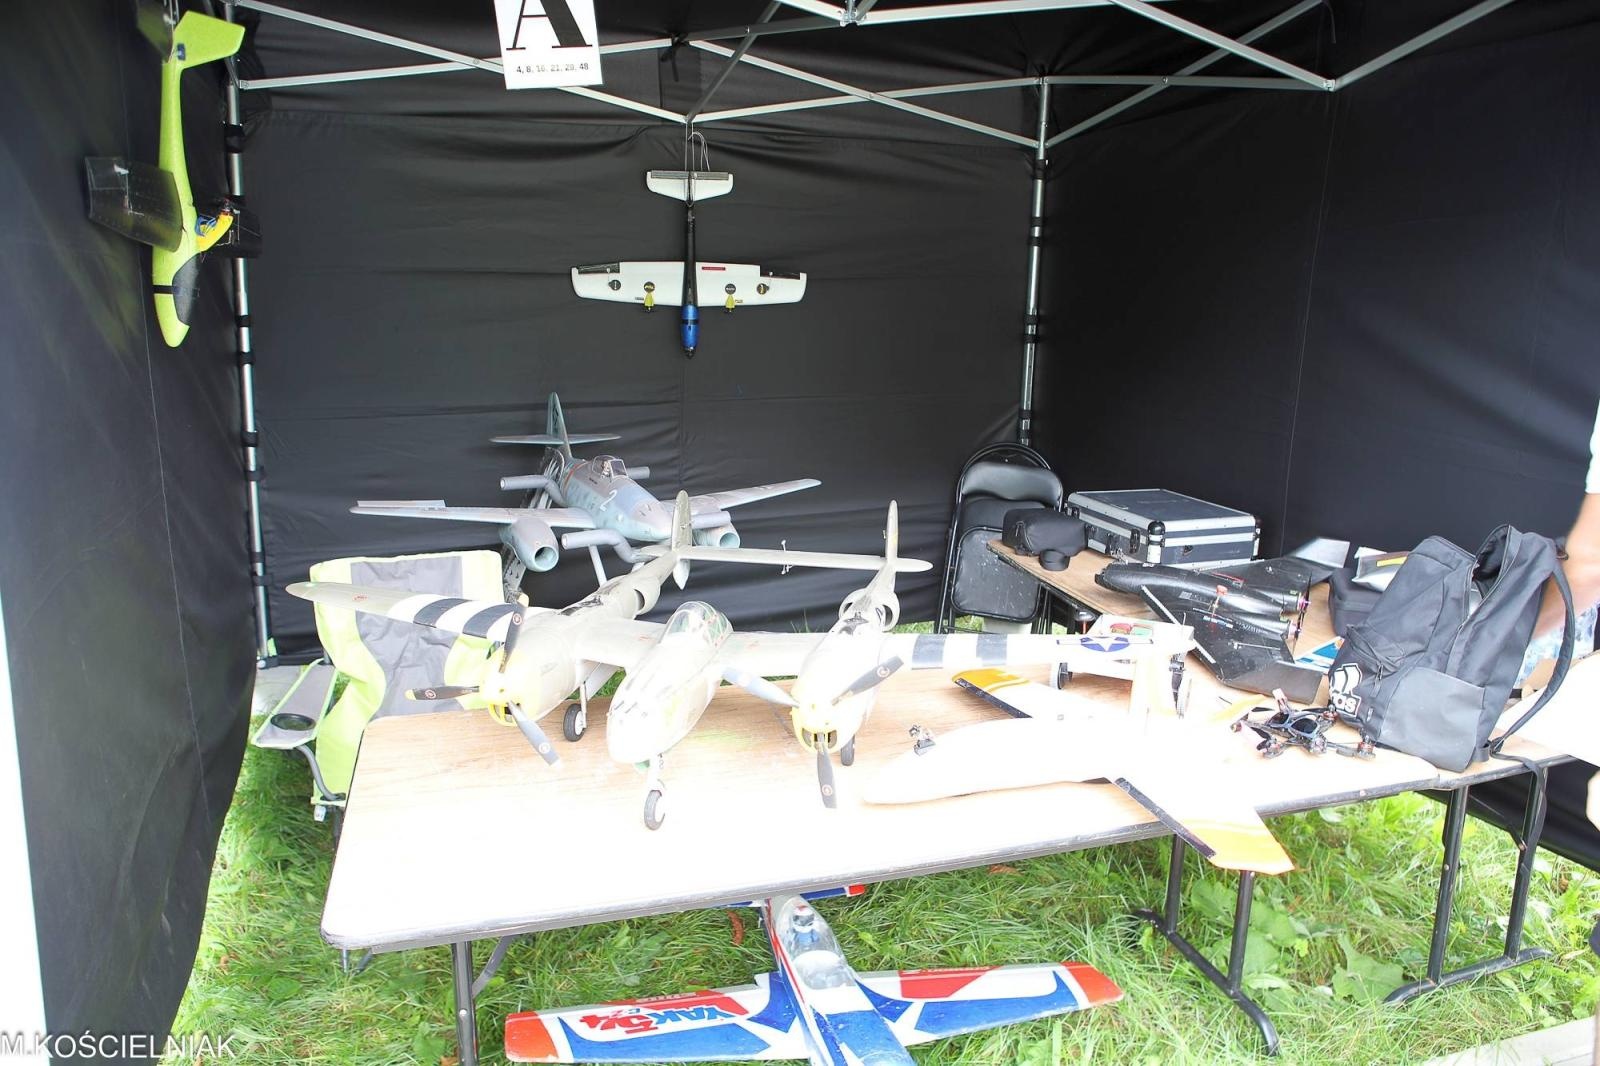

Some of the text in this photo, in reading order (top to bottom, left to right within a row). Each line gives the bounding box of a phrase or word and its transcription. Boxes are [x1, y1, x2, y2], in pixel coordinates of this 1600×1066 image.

[506, 0, 593, 51] A
[580, 62, 589, 71] 48
[600, 489, 618, 512] 2
